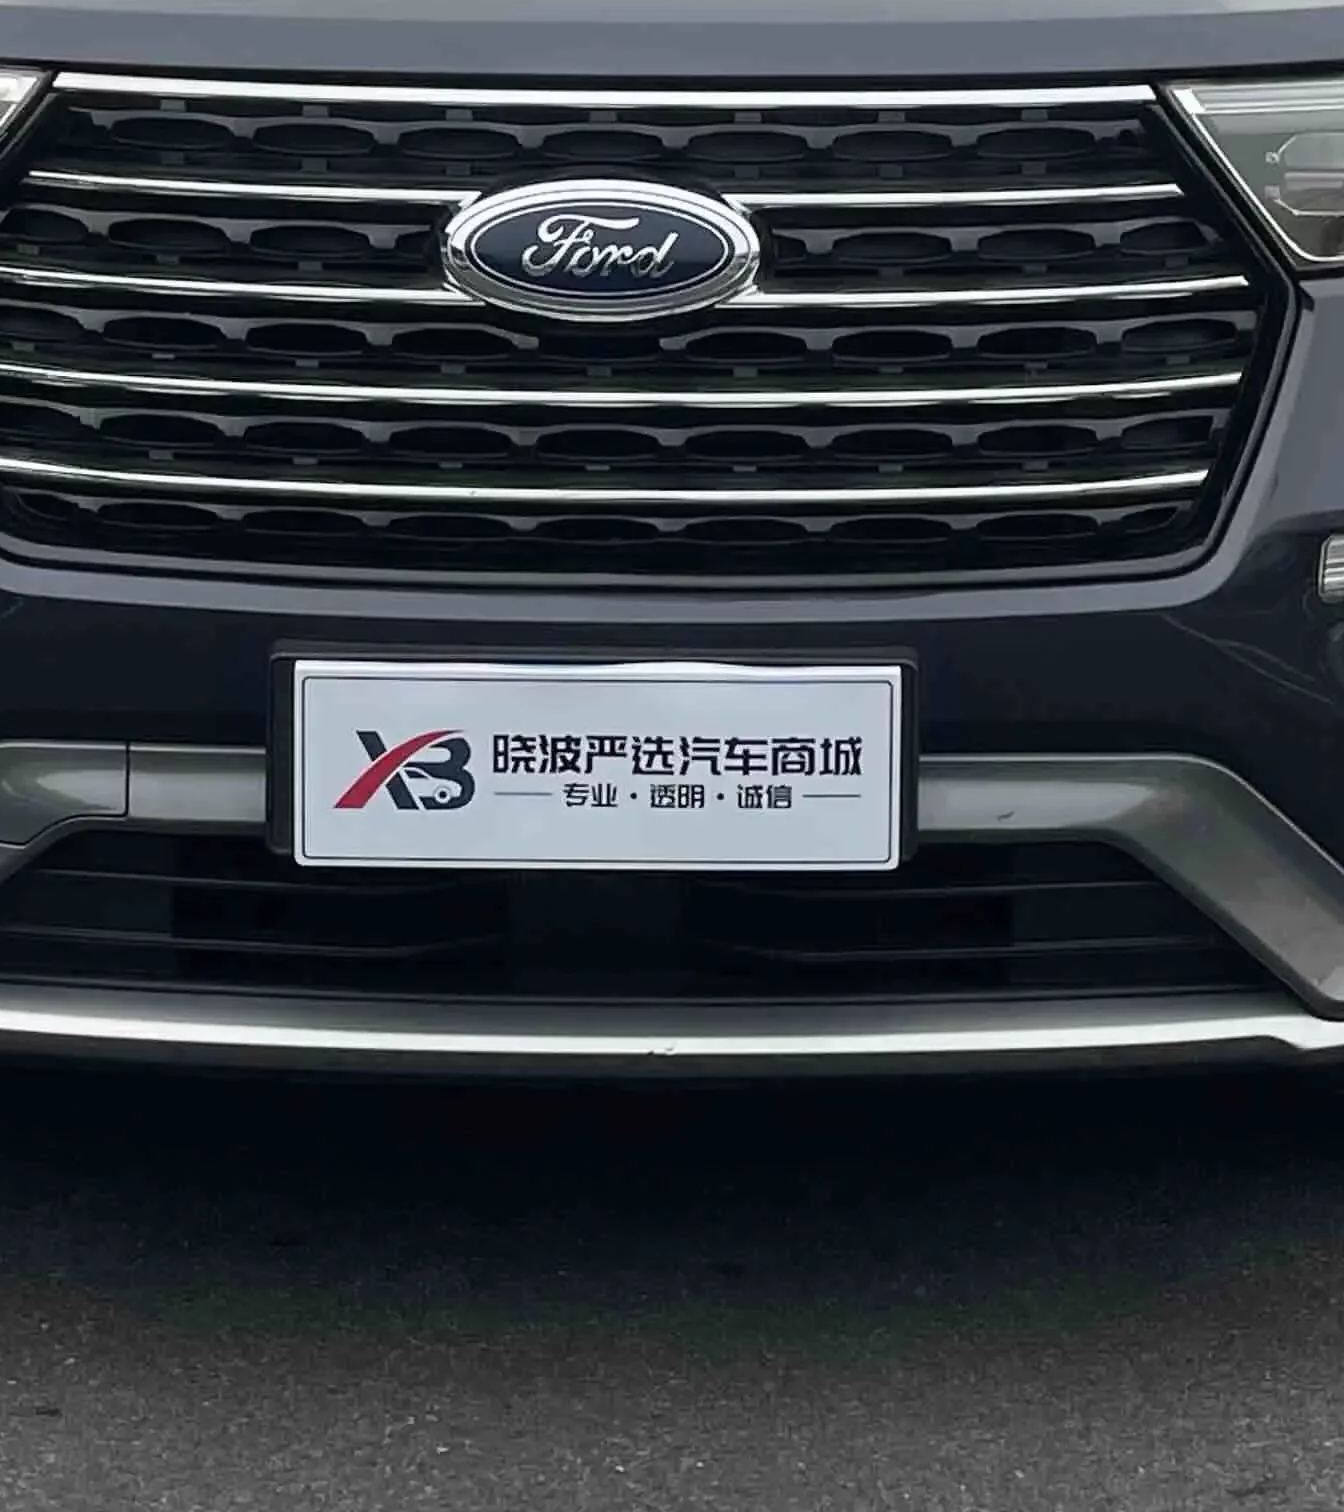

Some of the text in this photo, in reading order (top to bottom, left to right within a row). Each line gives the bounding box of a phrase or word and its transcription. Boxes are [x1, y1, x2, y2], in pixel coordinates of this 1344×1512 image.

[520, 212, 682, 278] Ford
[492, 733, 864, 777] 晓波严选汽车商城
